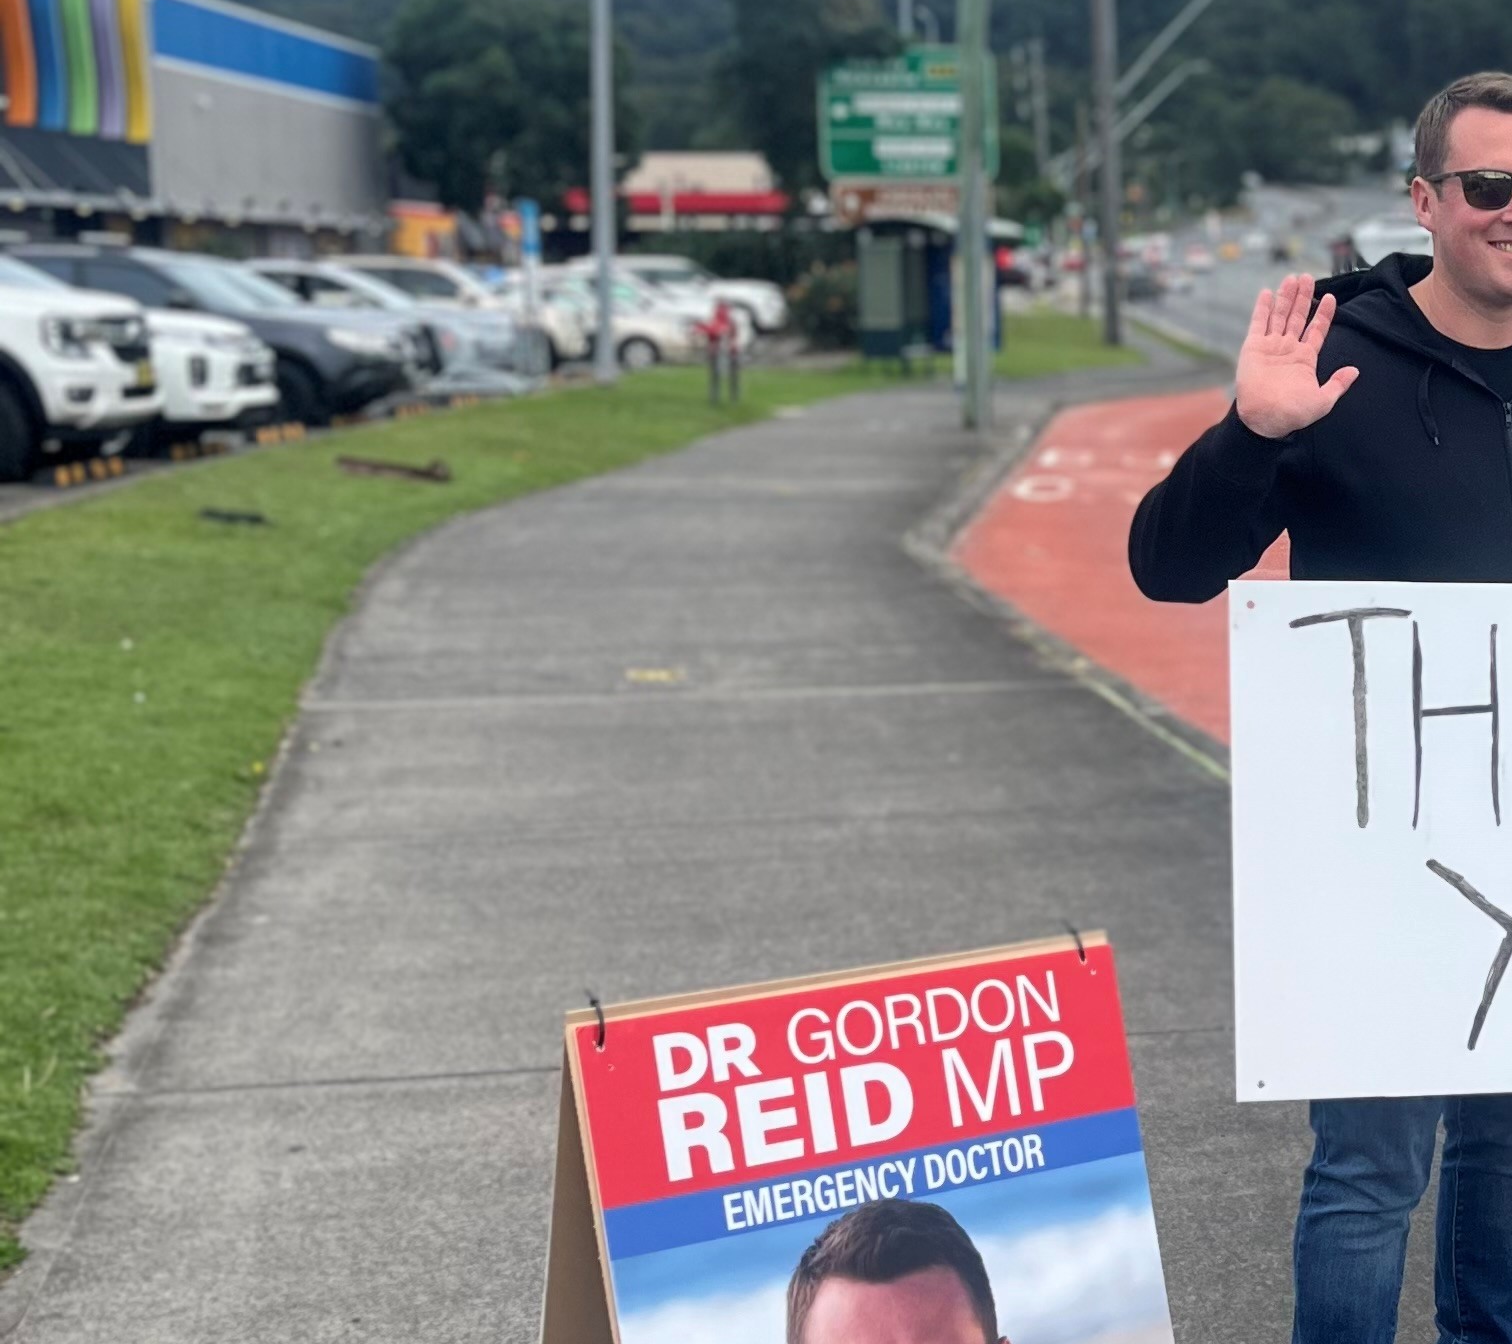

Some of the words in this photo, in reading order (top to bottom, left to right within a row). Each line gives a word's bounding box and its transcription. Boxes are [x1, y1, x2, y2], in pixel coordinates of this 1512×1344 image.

[653, 1023, 761, 1091] DR
[787, 971, 1060, 1064] GORDON
[658, 1062, 914, 1182] REID
[942, 1030, 1074, 1127] MP
[723, 1158, 917, 1231] EMERGENCY
[924, 1134, 1045, 1188] DOCTOR
